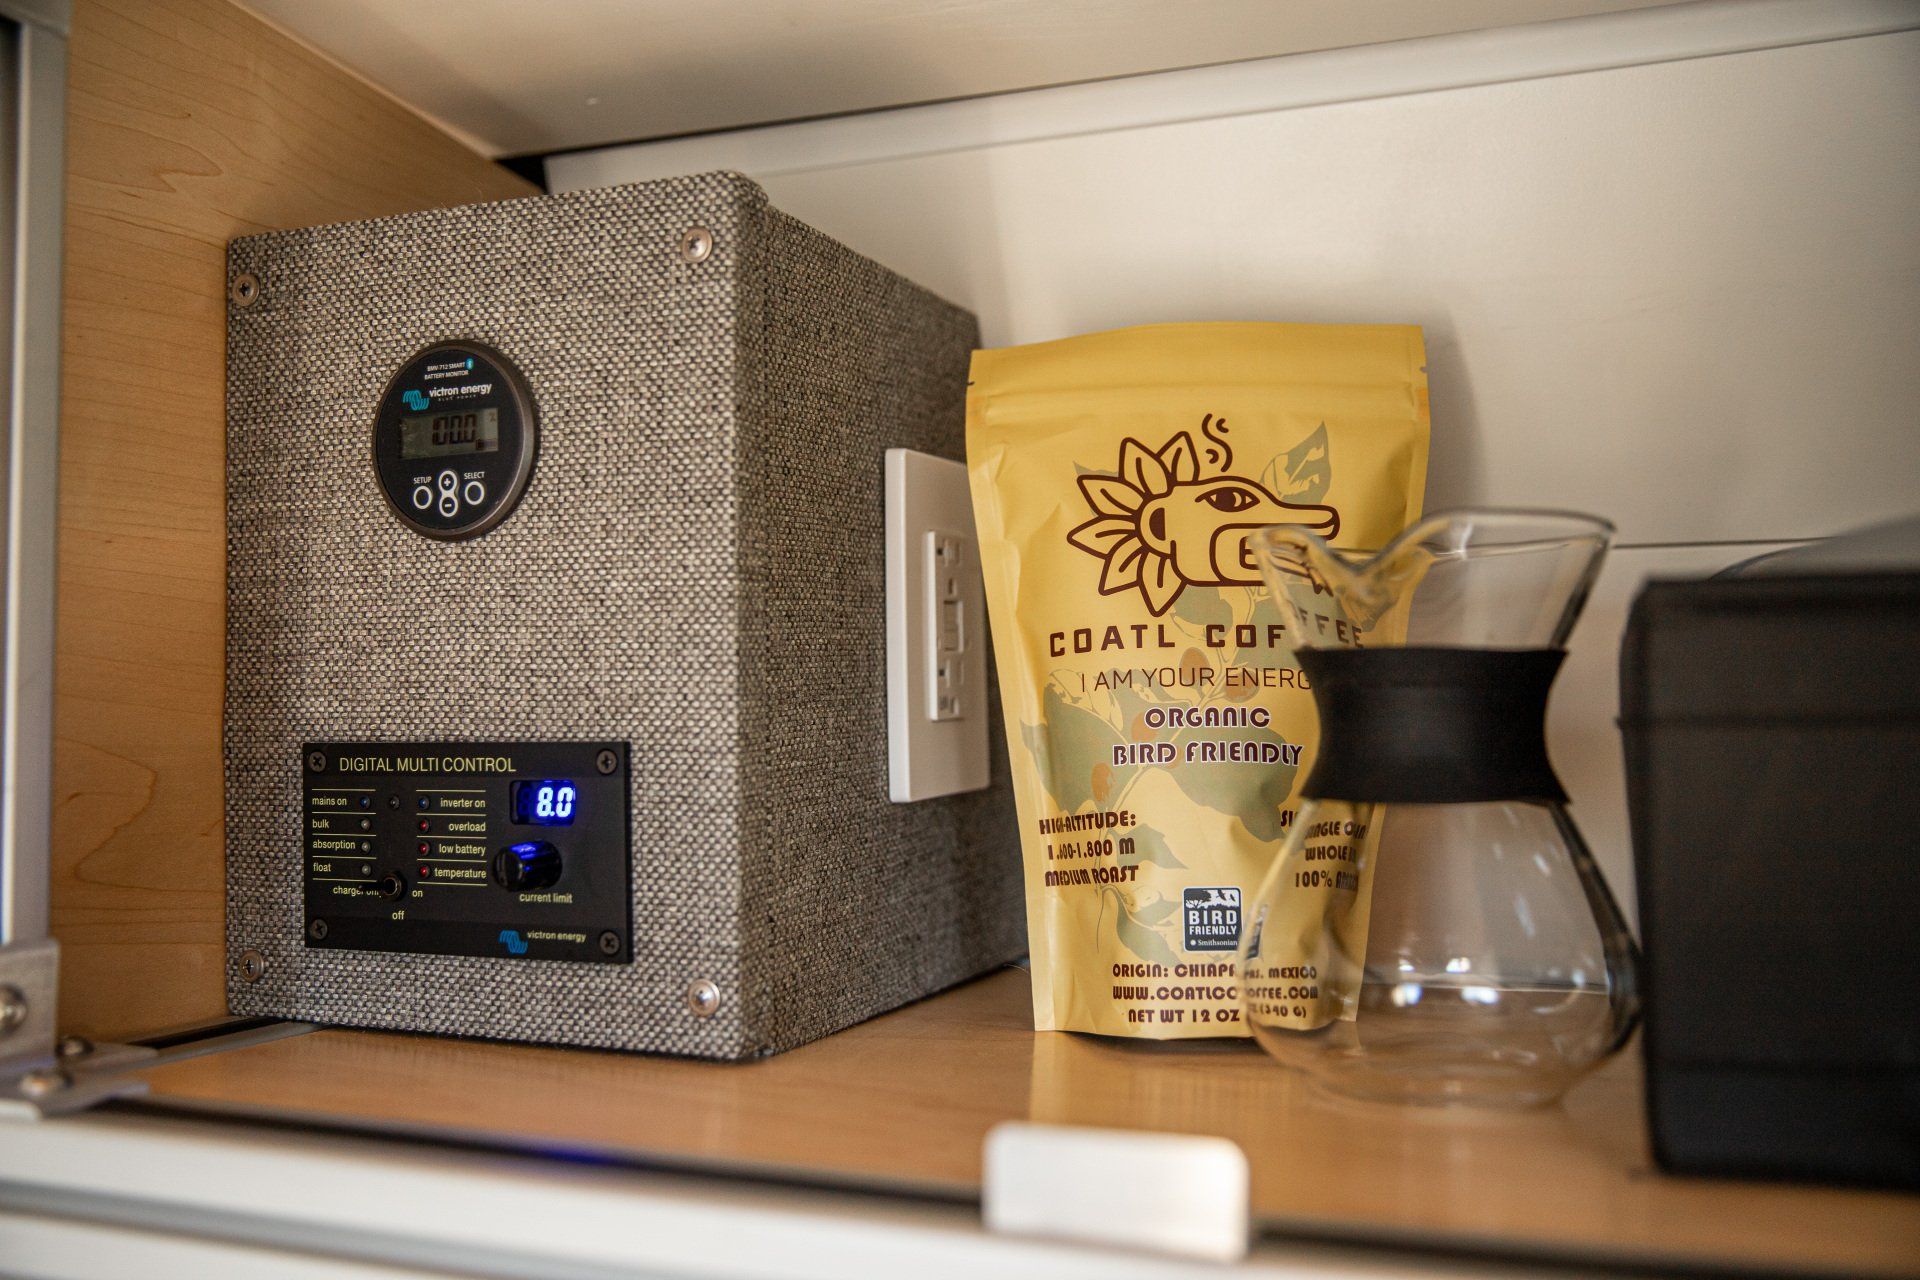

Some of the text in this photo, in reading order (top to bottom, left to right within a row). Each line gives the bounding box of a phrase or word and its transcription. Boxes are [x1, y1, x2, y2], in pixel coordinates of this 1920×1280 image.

[445, 370, 469, 378] MONITOR
[429, 384, 492, 397] victron energy
[464, 472, 485, 480] SELECT
[1050, 624, 1176, 657] COATL
[1081, 667, 1311, 692] I AM YOUR ENERG
[1144, 706, 1271, 729] ORGANIC
[1112, 741, 1304, 767] BIRD FRIENDLY
[339, 757, 516, 772] DIGITAL MULTI CONTROL
[312, 797, 334, 806] mains
[440, 798, 486, 808] inverter on
[536, 786, 574, 818] 8.0
[312, 819, 330, 829] bulk
[448, 821, 486, 832] overload
[312, 840, 356, 851] absorption
[438, 843, 487, 857] low battery
[313, 862, 331, 872] float
[434, 867, 487, 879] temperature
[1044, 864, 1139, 887] MEDIUM ROAST
[1295, 869, 1333, 888] 100%
[412, 889, 423, 898] on
[519, 892, 573, 904] current limit
[392, 910, 405, 920] off
[1188, 910, 1238, 925] BIRD
[527, 930, 586, 942] victron energy
[1189, 925, 1237, 935] FRIENDLY
[1197, 938, 1238, 947] Smithsonian
[1112, 963, 1169, 978] ORIGIN:
[1268, 966, 1317, 979] MEXICO
[1128, 1008, 1155, 1023] NET
[1160, 1008, 1185, 1023] WT
[1215, 1008, 1240, 1023] OZ
